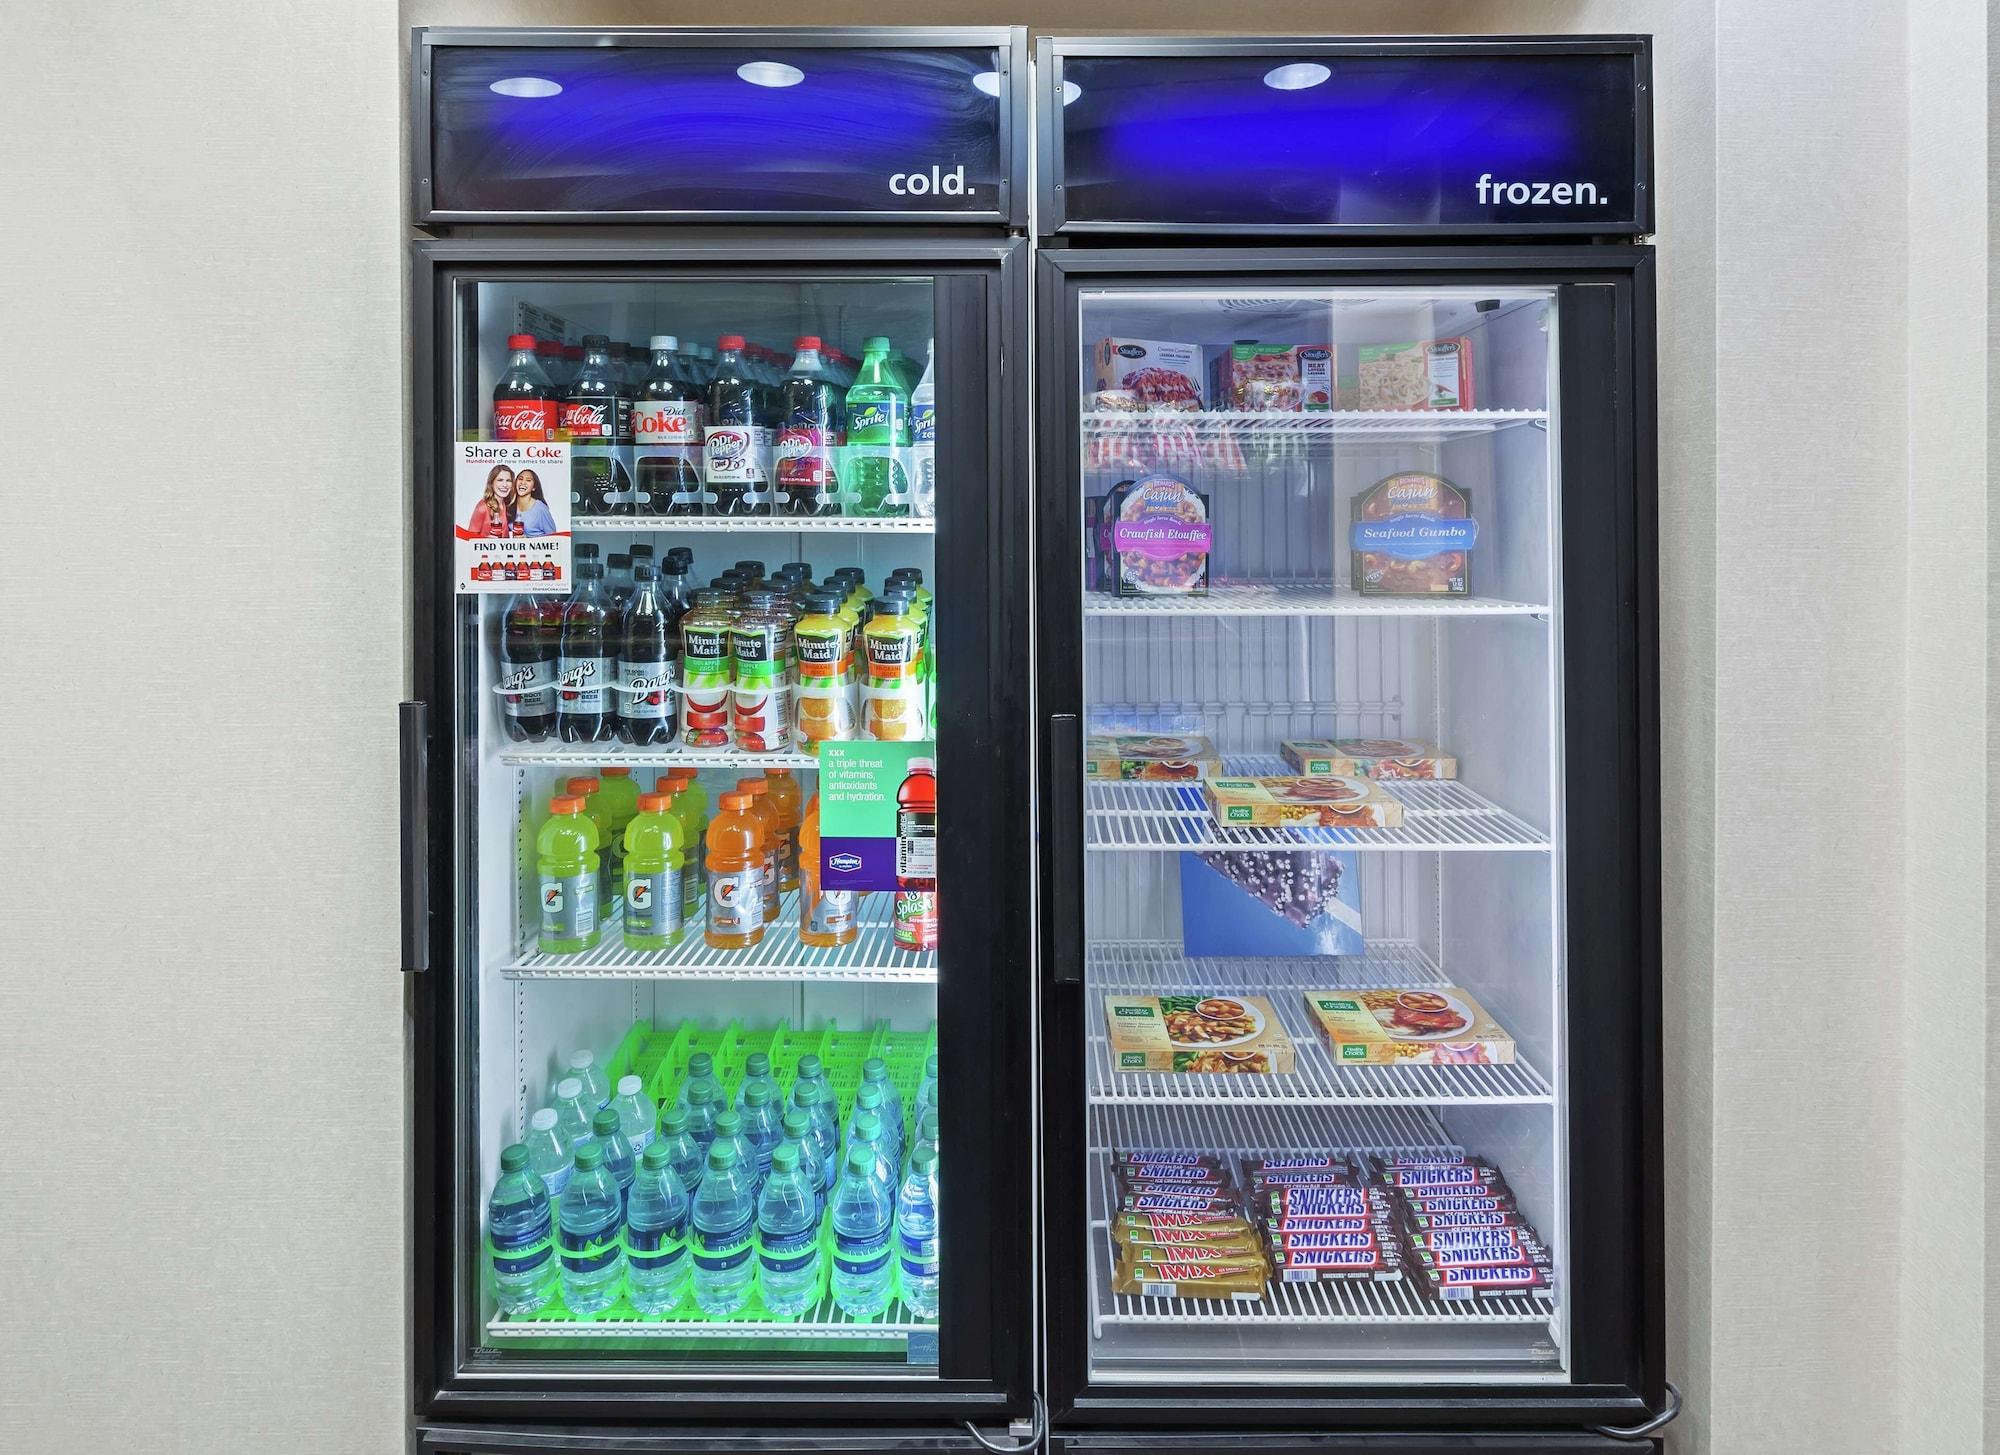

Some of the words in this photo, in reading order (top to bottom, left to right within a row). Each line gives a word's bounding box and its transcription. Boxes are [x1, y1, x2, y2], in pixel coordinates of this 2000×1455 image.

[889, 165, 976, 196] cold.
[1476, 173, 1608, 205] frozen.
[1303, 350, 1330, 360] Stouffer's
[663, 405, 686, 416] Diet
[635, 411, 687, 433] Coke
[853, 411, 885, 431] Sprite
[465, 446, 508, 458] Share
[512, 448, 521, 458] a
[526, 446, 562, 458] Coke
[1143, 488, 1184, 502] Cajun
[1387, 486, 1438, 500] Cajun
[1119, 528, 1165, 540] Crawfish
[1167, 529, 1207, 541] Etouffee
[1363, 528, 1415, 540] Seafood
[1418, 526, 1467, 538] Gumbo
[474, 543, 497, 551] FIND
[500, 543, 526, 551] YOUR
[529, 542, 559, 550] NAME!
[688, 634, 726, 645] Minute
[797, 637, 838, 650] Minute
[693, 645, 720, 655] Maid
[803, 648, 832, 659] Maid
[874, 649, 903, 661] Maid
[837, 759, 857, 769] triple
[860, 760, 883, 768] threat
[839, 770, 876, 780] vitamins,
[829, 781, 878, 790] antioxidants
[829, 792, 845, 800] and
[847, 792, 887, 801] hydration.
[1132, 1152, 1198, 1165] SNICKERS
[1140, 1167, 1208, 1178] SNICKERS
[1268, 1174, 1333, 1183] SNICKERS
[1402, 1168, 1473, 1185] SNICKERS
[1147, 1184, 1217, 1196] SNICKERS
[1290, 1188, 1361, 1204] SNICKERS
[1420, 1186, 1486, 1196] SNICKERS
[1139, 1196, 1208, 1209] SNICKERS
[1428, 1200, 1496, 1210] SNICKERS
[1289, 1203, 1365, 1216] SNICKERS
[1147, 1213, 1202, 1228] TWIX
[1286, 1219, 1363, 1230] SNICKERS
[1434, 1214, 1503, 1227] SNICKERS
[1151, 1227, 1206, 1244] TWIX
[1290, 1232, 1369, 1247] SNICKERS
[1433, 1230, 1511, 1250] SNICKERS
[1162, 1245, 1221, 1263] TWIX
[1293, 1251, 1376, 1265] SNICKERS
[1442, 1246, 1520, 1263] SNICKERS
[1151, 1263, 1215, 1281] TWIX
[1449, 1267, 1532, 1281] SNICKERS
